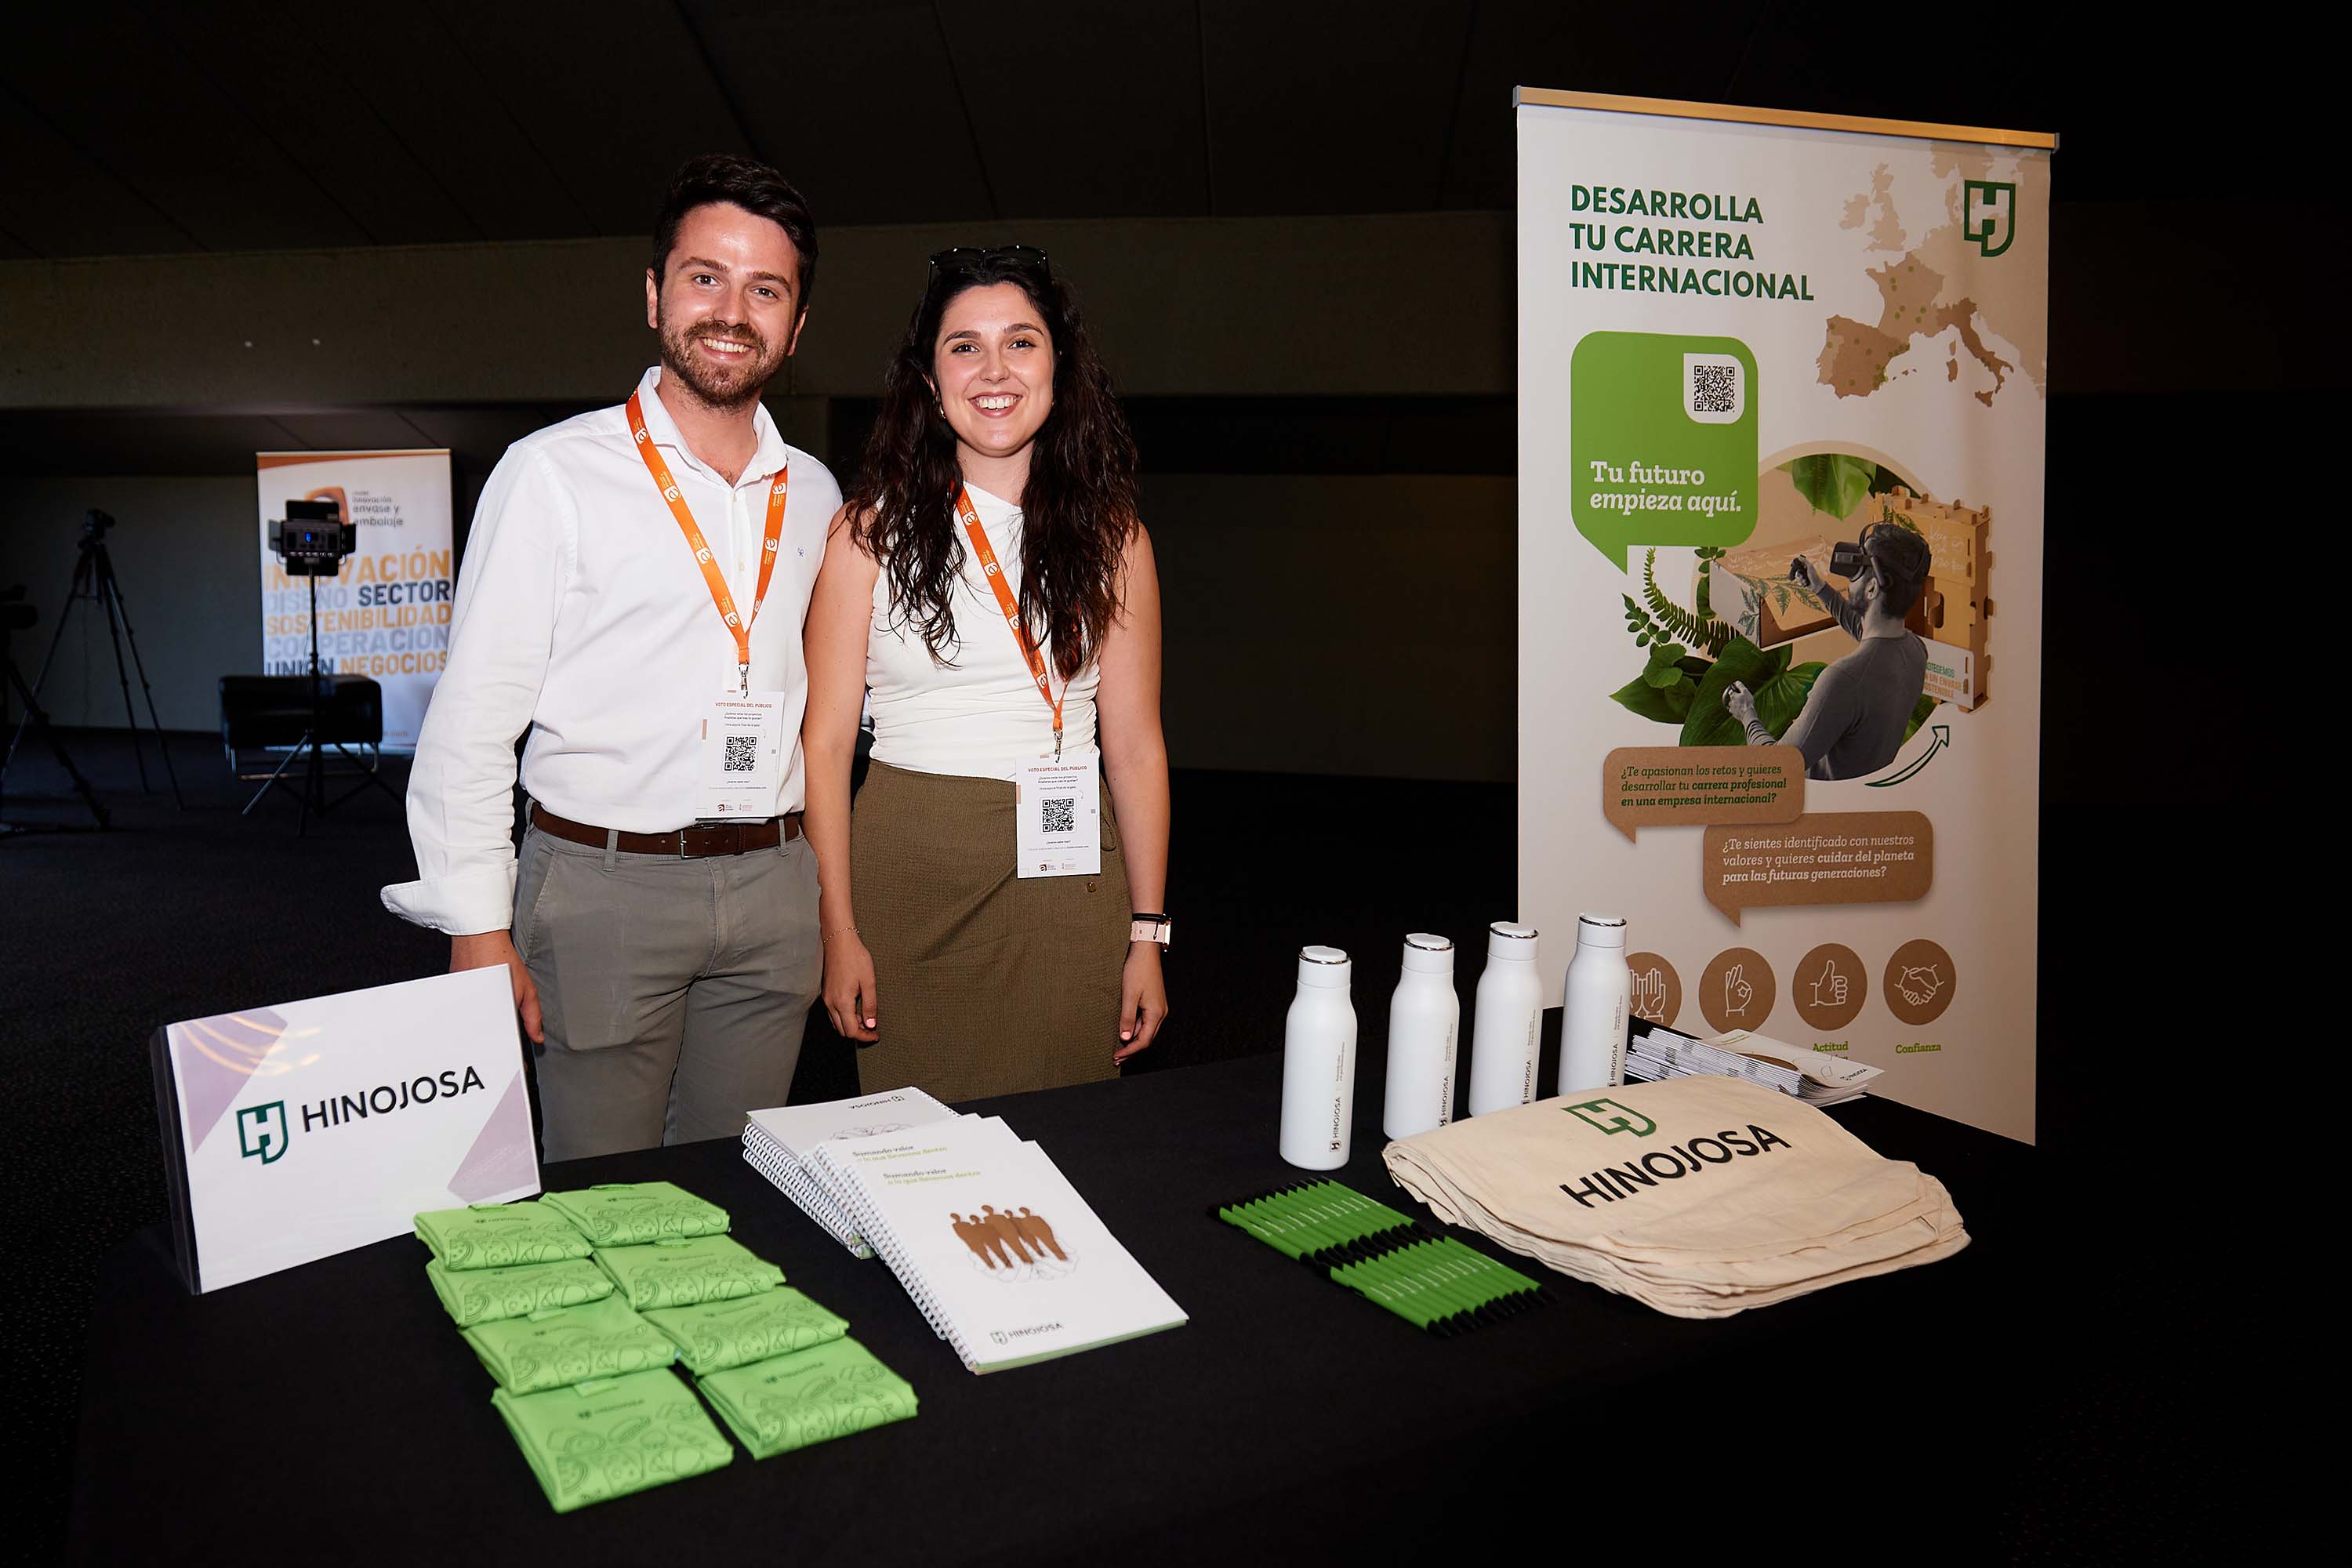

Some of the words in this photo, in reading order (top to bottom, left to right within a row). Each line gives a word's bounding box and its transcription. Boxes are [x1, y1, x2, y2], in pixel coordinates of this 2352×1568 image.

[1571, 184, 1764, 223] DESARROLLA
[1569, 223, 1606, 251] TU
[1614, 226, 1755, 260] CARRERA
[1572, 261, 1814, 301] INTERNACIONAL
[1590, 461, 1624, 483] Tu
[1629, 461, 1705, 485] futuro
[1590, 488, 1682, 516] empieza
[1687, 490, 1742, 517] aquí.
[358, 579, 451, 608] SECTOR
[339, 650, 447, 677] NEGOCIOS
[1621, 765, 1639, 779] ¿Te
[1642, 767, 1693, 779] apasionan
[1696, 764, 1710, 775] los
[1712, 765, 1737, 775] retos
[1739, 767, 1745, 777] y
[1747, 764, 1781, 776] quieres
[1621, 780, 1675, 792] desarrollar
[1679, 782, 1690, 791] tu
[1692, 781, 1728, 790] carrera
[1730, 778, 1787, 792] profesional
[1621, 797, 1634, 807] en
[1636, 797, 1656, 806] una
[1658, 795, 1701, 808] empresa
[1704, 793, 1777, 805] internacional?
[1722, 838, 1741, 853] ¿Te
[1744, 837, 1781, 849] sientes
[1784, 835, 1847, 851] identificado
[1849, 837, 1868, 847] con
[1871, 835, 1915, 846] nuestros
[1723, 855, 1762, 866] valores
[1766, 856, 1772, 868] y
[1775, 854, 1814, 867] quieres
[1817, 851, 1853, 863] cuidar
[1856, 851, 1871, 862] del
[1874, 850, 1915, 864] planeta
[1722, 872, 1748, 885] para
[1751, 869, 1766, 881] las
[1767, 869, 1809, 884] futuras
[1811, 866, 1887, 882] generaciones?
[1813, 1041, 1848, 1052] Actitud
[1896, 1042, 1942, 1054] Confianza
[301, 1065, 485, 1132] HINOJOSA
[1332, 1097, 1341, 1138] HINOJOSA
[1559, 1124, 1792, 1208] HINOJOSA
[1008, 1323, 1065, 1338] HINOJOSA
